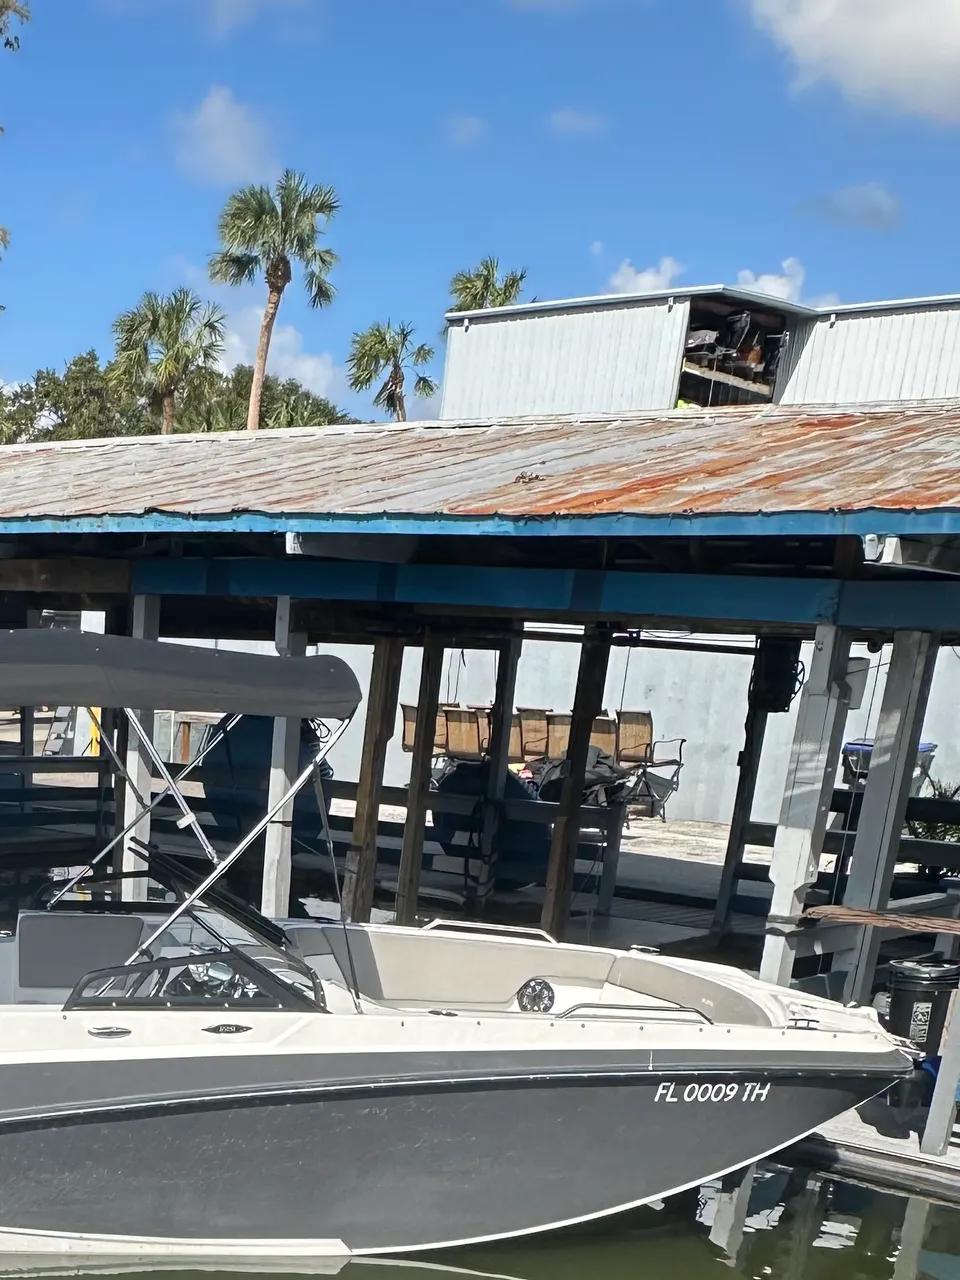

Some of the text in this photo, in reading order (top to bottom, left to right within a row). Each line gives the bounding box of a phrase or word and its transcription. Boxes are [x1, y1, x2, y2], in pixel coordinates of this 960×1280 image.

[654, 1082, 771, 1102] FL 0009 TH
